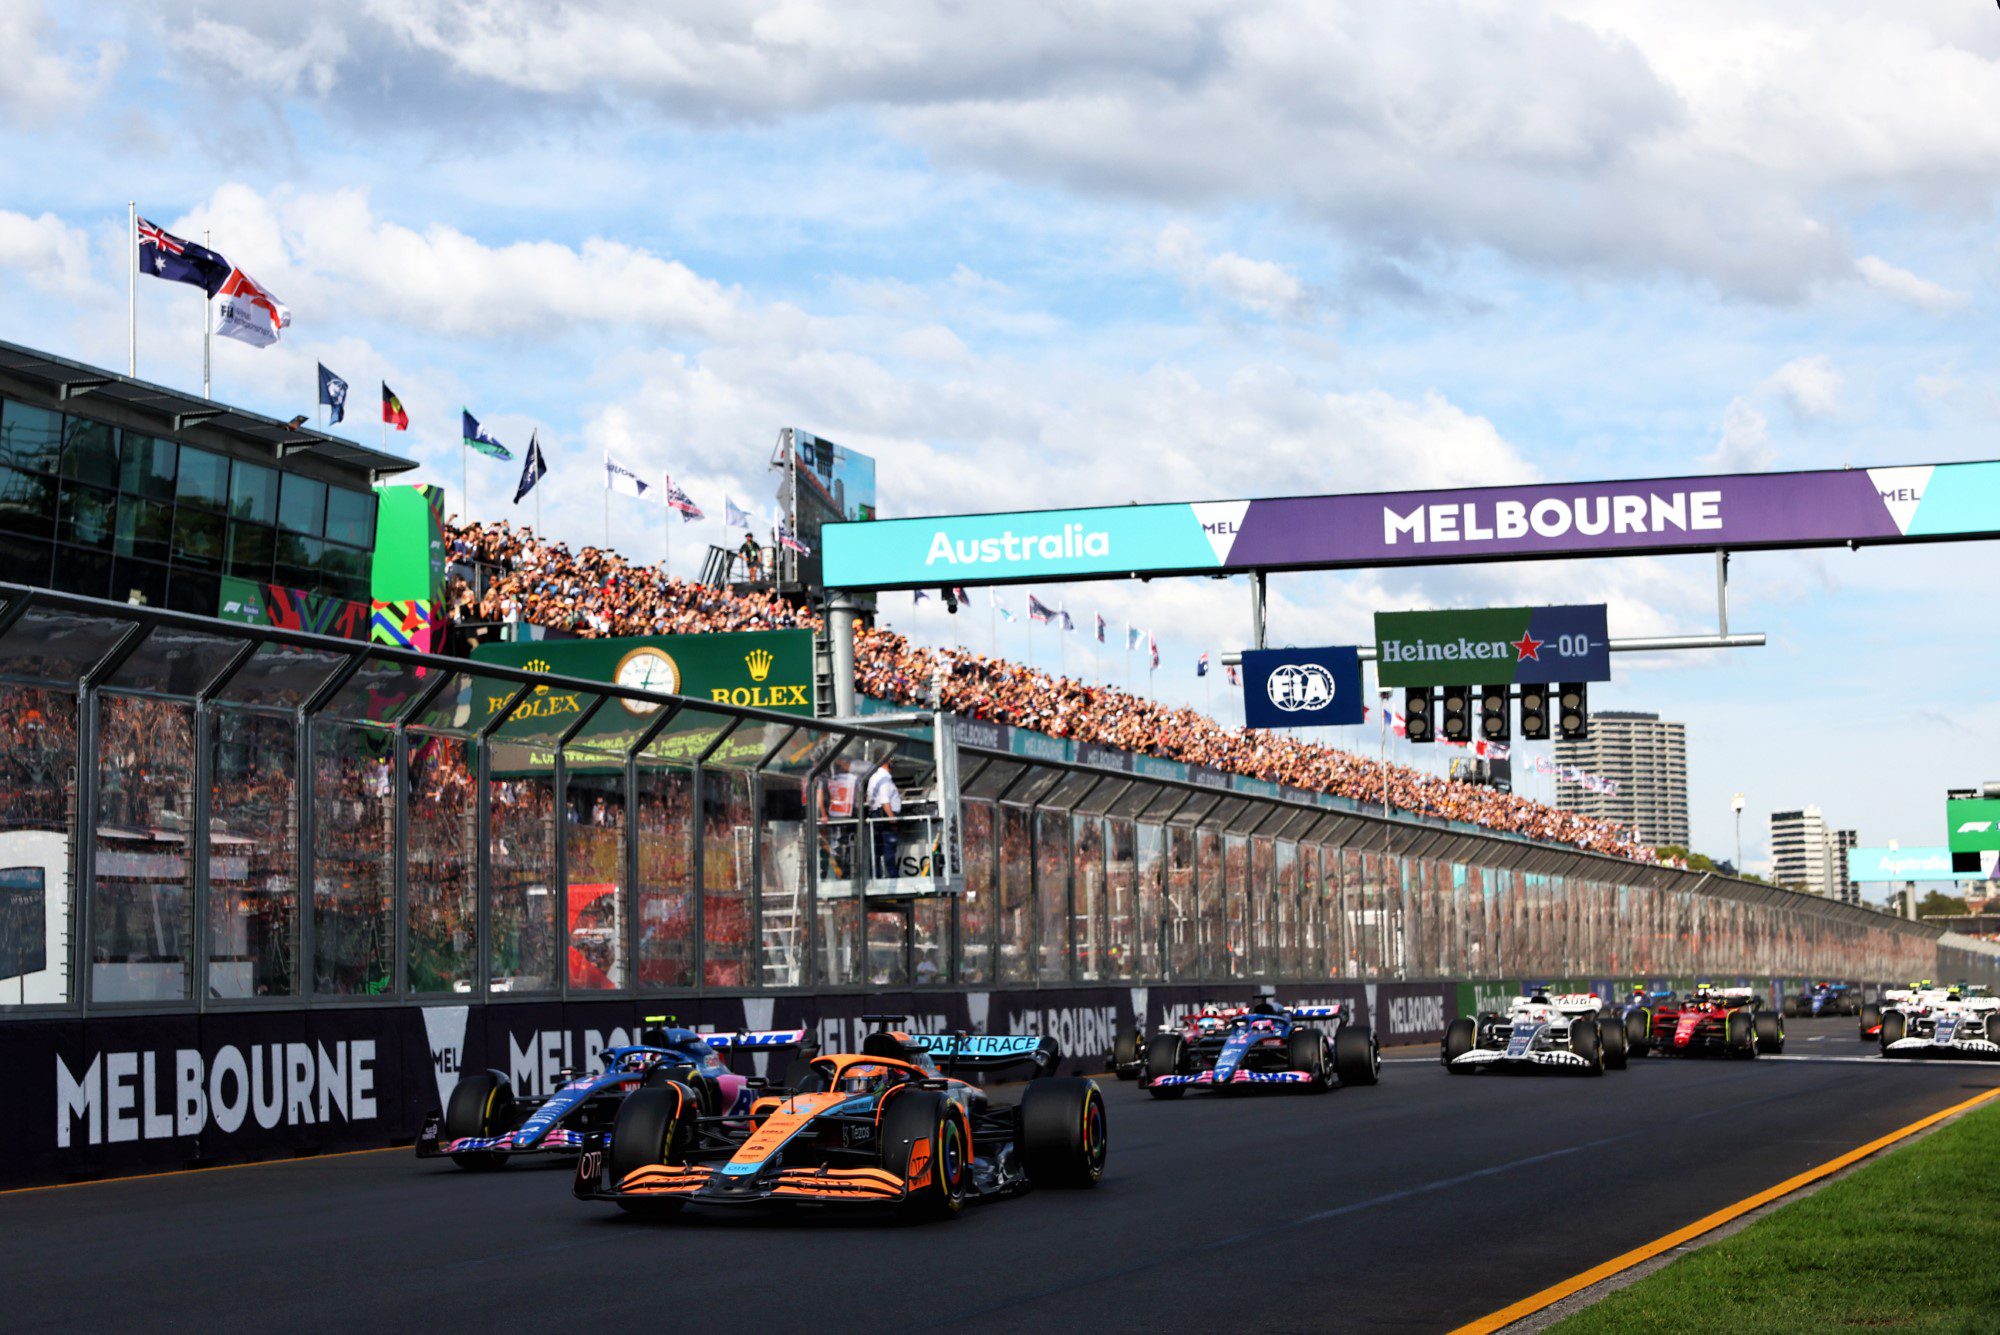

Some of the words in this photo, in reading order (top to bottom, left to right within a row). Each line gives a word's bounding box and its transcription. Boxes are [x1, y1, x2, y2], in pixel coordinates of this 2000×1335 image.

[1881, 488, 1921, 503] MEL
[1202, 521, 1239, 535] MEL
[1383, 491, 1723, 545] MELBOURNE
[925, 523, 1110, 566] Australia
[1382, 637, 1509, 662] Heineken
[710, 685, 808, 707] ROLEX
[1388, 996, 1445, 1034] MELBOURNE
[705, 1033, 795, 1046] BWT
[917, 1035, 1037, 1054] DARKTRACE
[1009, 1006, 1118, 1058] MELBOURNE
[431, 1047, 461, 1073] MEL
[56, 1039, 377, 1148] MELBOURNE
[851, 1124, 870, 1138] Tezos
